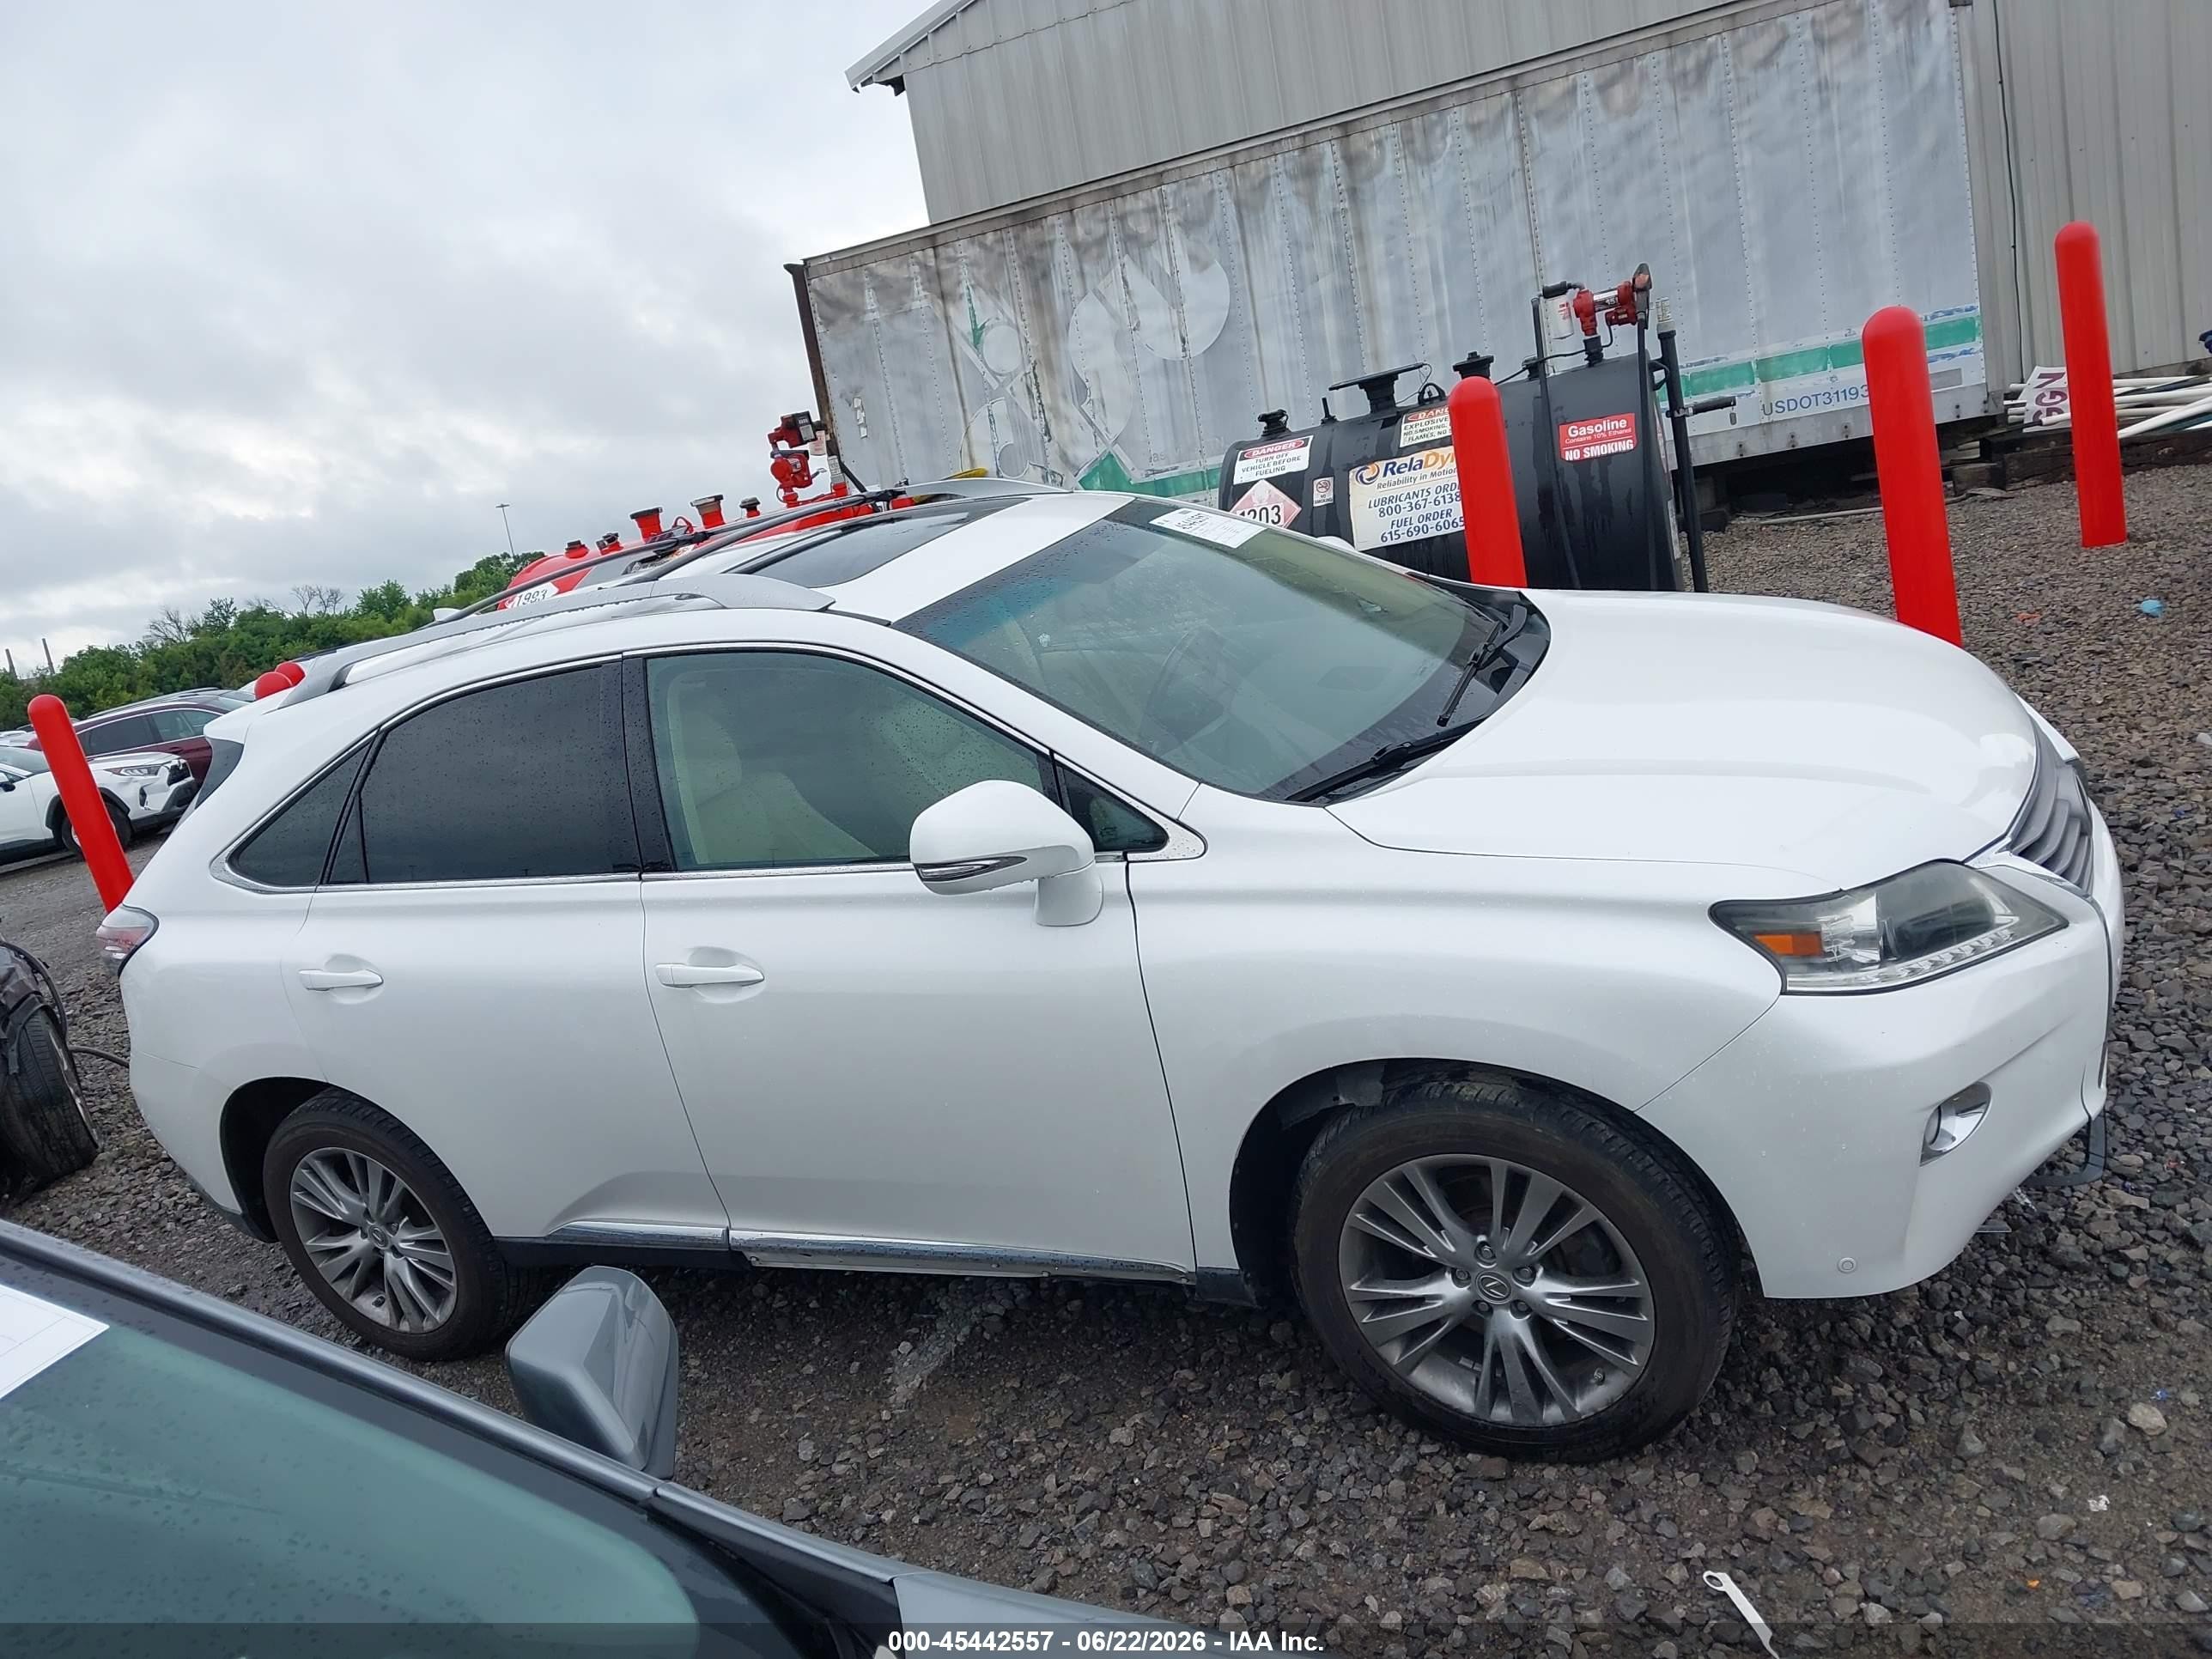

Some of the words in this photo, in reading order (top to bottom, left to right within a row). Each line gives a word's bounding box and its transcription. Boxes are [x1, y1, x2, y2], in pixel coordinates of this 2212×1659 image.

[1565, 435, 1592, 444] Contains
[1608, 428, 1632, 436] Ethanol
[1568, 419, 1627, 438] Gasoline
[1252, 442, 1296, 456] DANGER
[1565, 449, 1581, 461] NO
[1583, 439, 1634, 459] SMOKING
[1242, 461, 1272, 473] VEHICLE
[1273, 455, 1302, 466] BEFORE
[1255, 465, 1286, 477] FUELING
[1376, 475, 1418, 490] Reliability
[1368, 487, 1431, 509] LUBRICANTS
[1435, 482, 1459, 495] ORD
[1378, 490, 1461, 518] 800-367-6138
[1390, 518, 1414, 530] FUEL
[1417, 507, 1453, 525] ORDER
[1380, 516, 1464, 543] 615-690-6065
